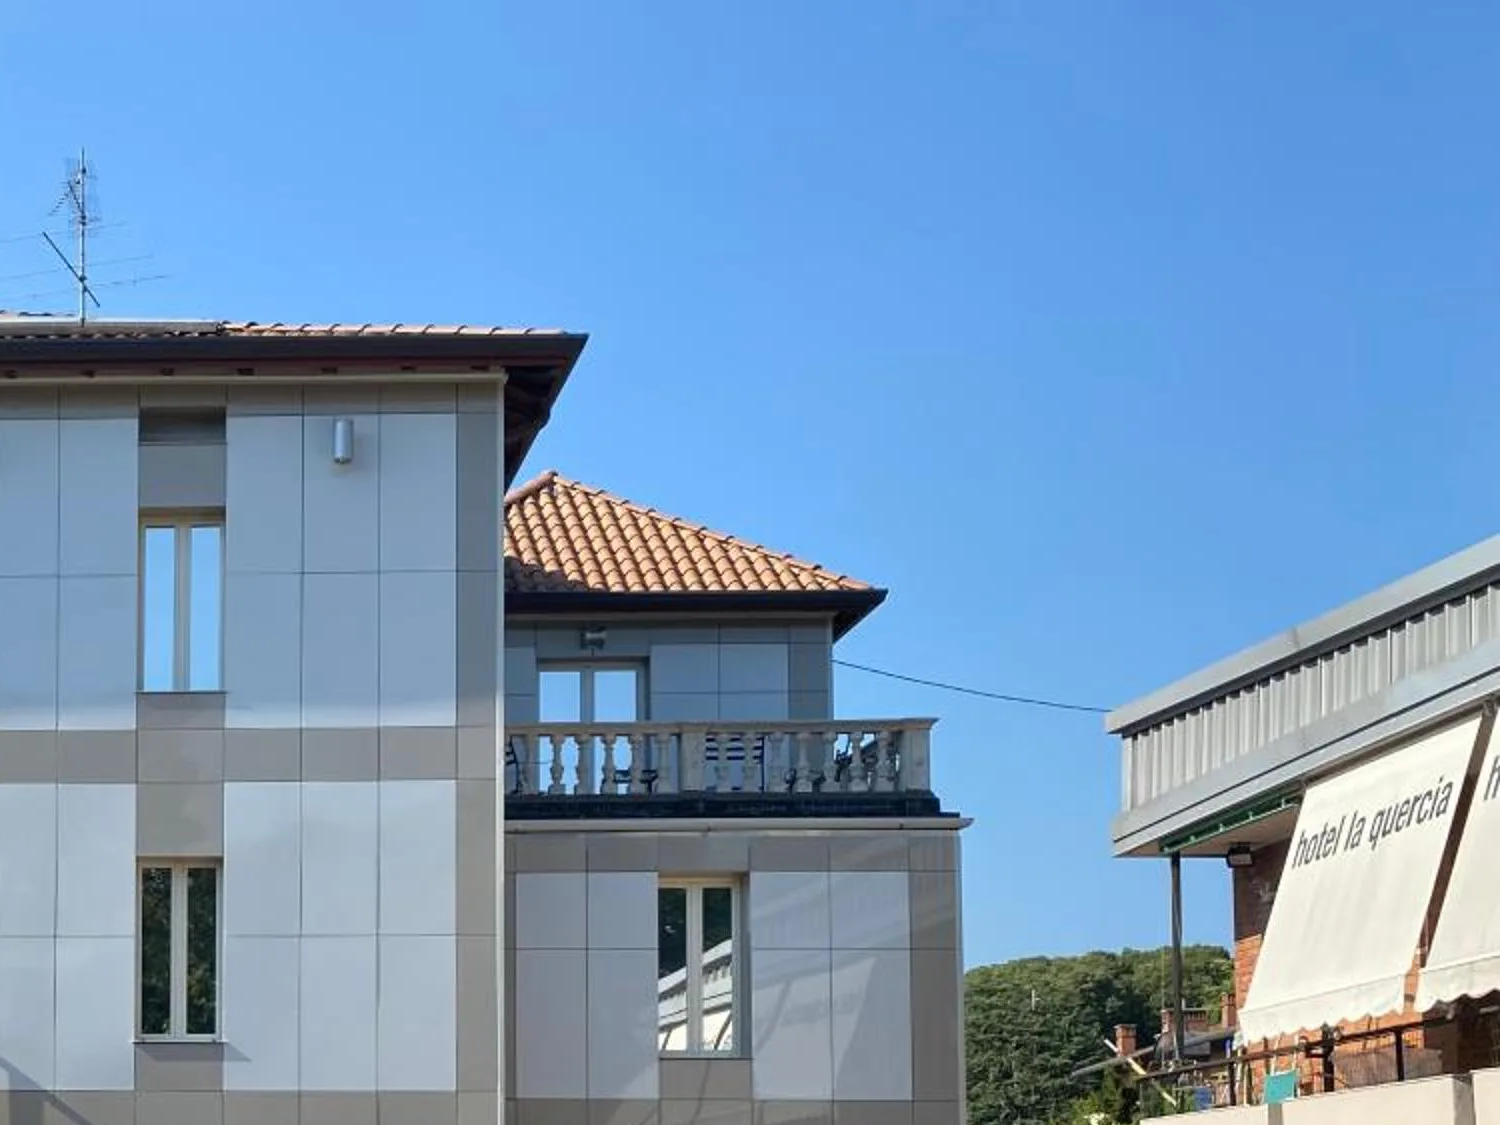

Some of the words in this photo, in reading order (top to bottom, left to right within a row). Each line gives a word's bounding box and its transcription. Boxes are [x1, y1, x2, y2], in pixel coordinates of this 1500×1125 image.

[1291, 815, 1347, 869] hotel
[1343, 809, 1367, 851] la
[1368, 775, 1454, 850] quercia
